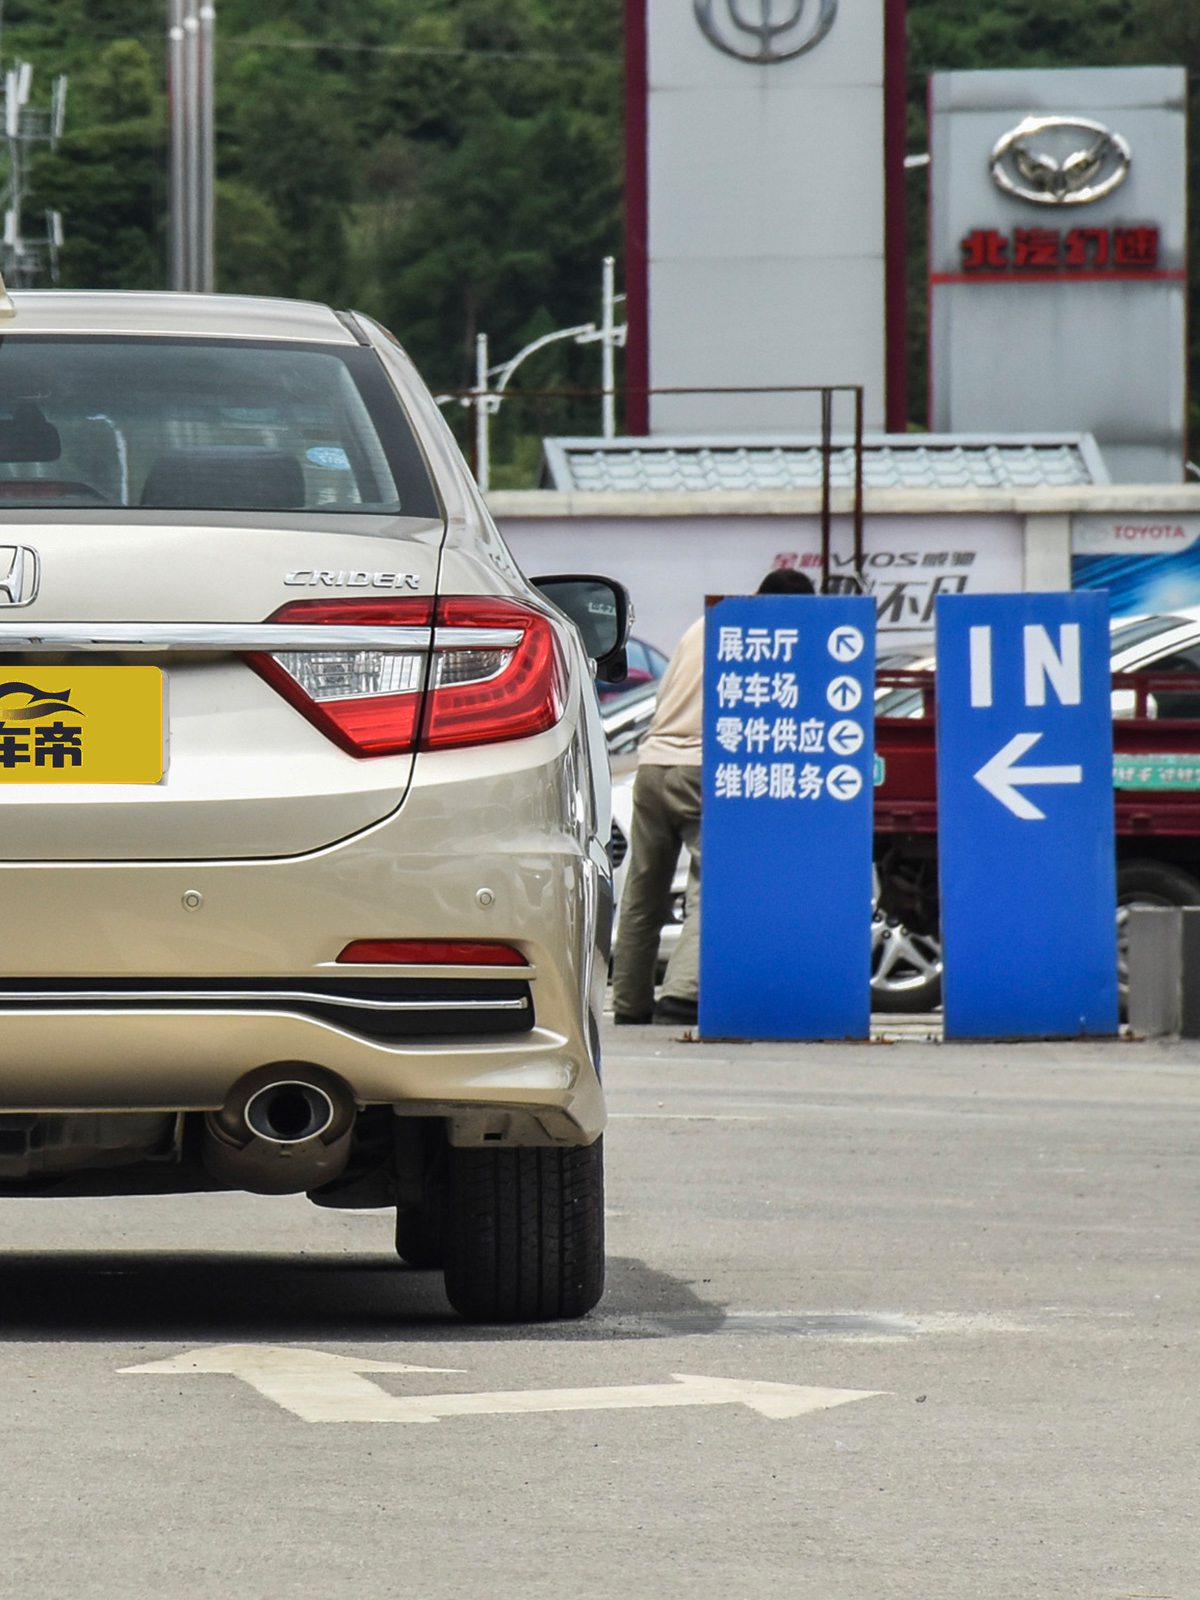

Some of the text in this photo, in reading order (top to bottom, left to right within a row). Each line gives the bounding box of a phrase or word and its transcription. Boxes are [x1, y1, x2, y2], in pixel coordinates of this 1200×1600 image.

[962, 226, 1158, 266] 北汽幻速
[1113, 526, 1185, 540] TOYOTA
[284, 570, 420, 590] CRIDER
[717, 626, 799, 662] 展示厅
[969, 623, 1081, 708] IN
[716, 671, 799, 709] 停车场
[716, 717, 825, 753] 零件供应
[715, 763, 823, 800] 维修服务
